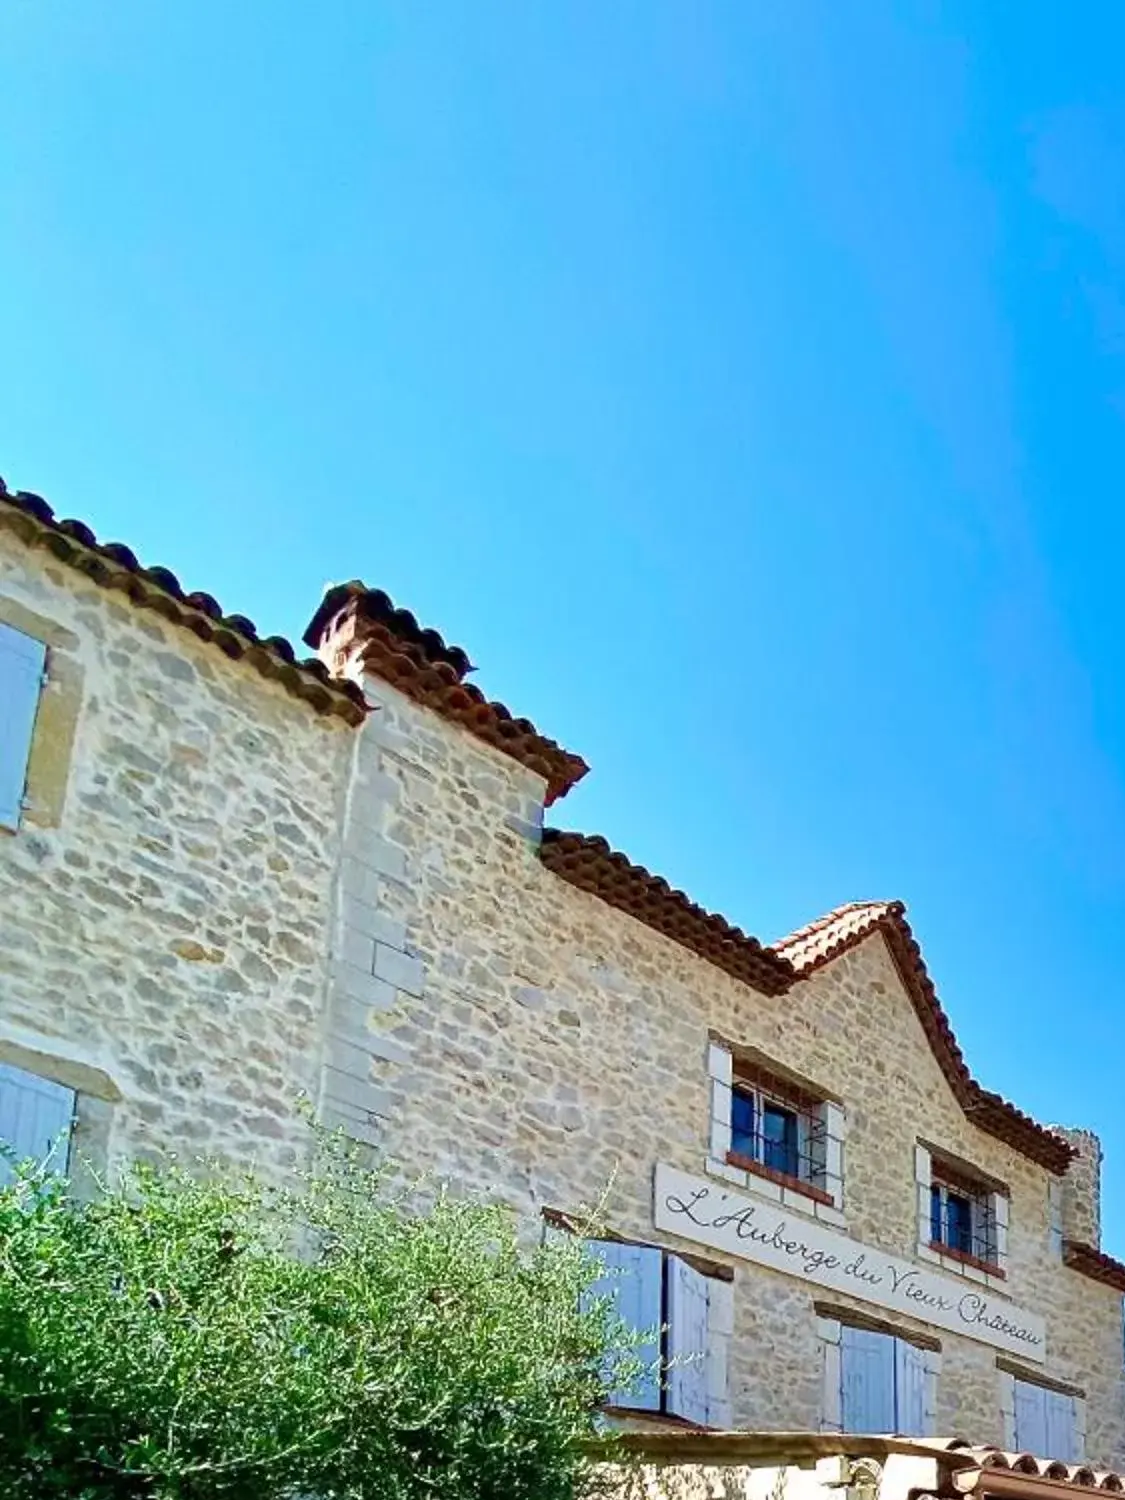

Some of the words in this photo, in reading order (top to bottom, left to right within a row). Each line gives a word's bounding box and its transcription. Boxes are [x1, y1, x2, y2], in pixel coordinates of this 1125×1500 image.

[665, 1187, 841, 1273] L'Auberge
[843, 1253, 883, 1286] du
[887, 1265, 953, 1312] Vieux
